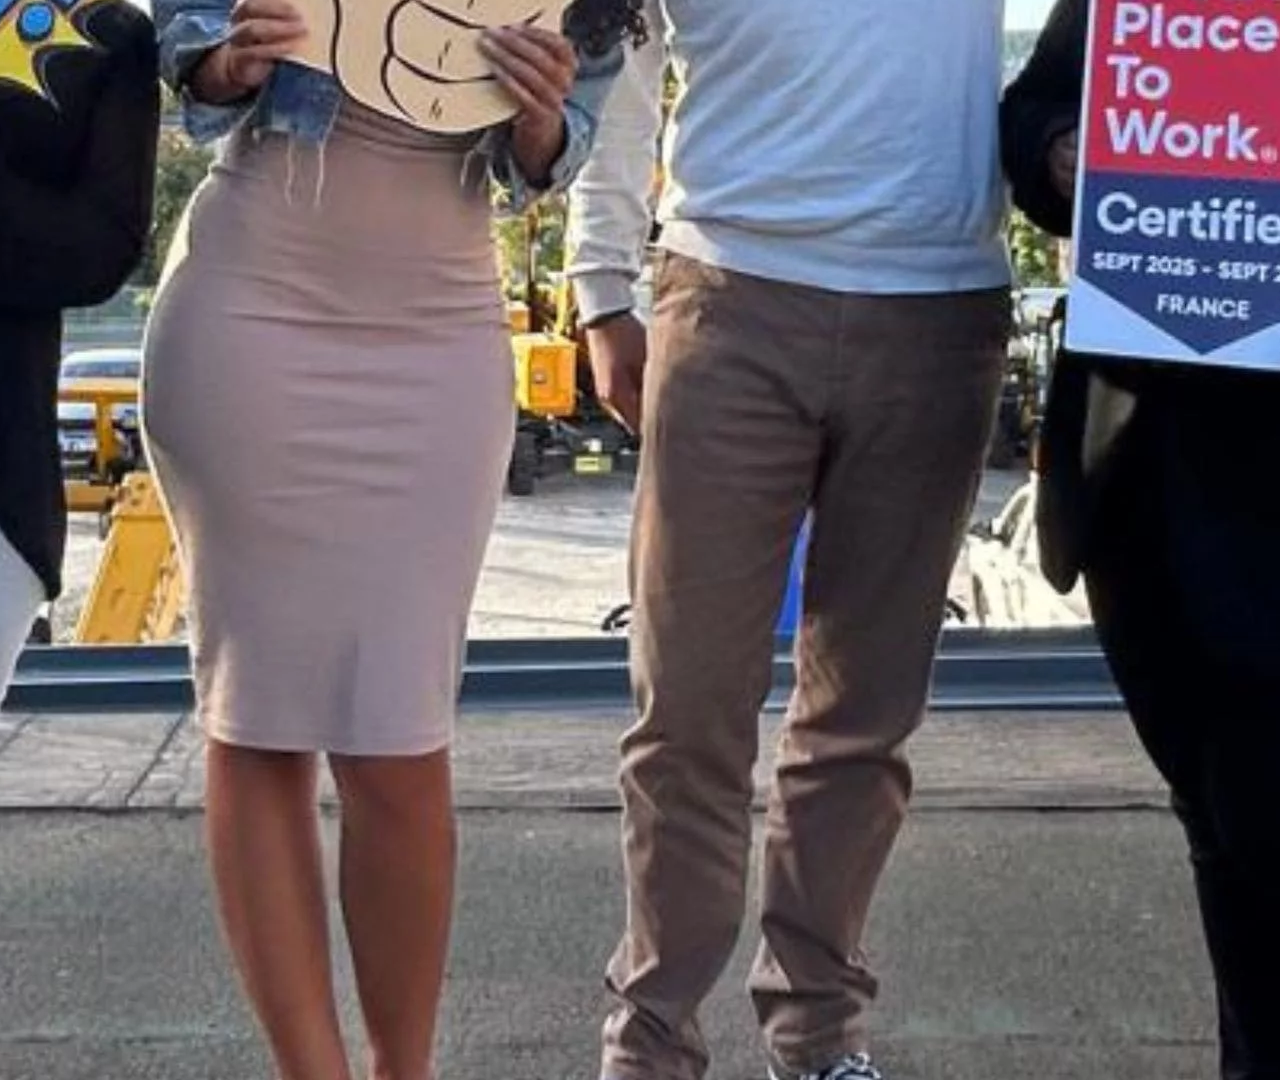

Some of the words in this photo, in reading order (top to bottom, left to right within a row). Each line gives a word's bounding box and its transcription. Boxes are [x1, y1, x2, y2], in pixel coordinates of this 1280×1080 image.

[1112, 2, 1280, 52] Place
[1107, 53, 1171, 100] To
[1092, 251, 1142, 273] SEPT
[1145, 255, 1197, 277] 2025
[1218, 261, 1271, 283] SEPT
[1156, 293, 1252, 319] FRANCE
